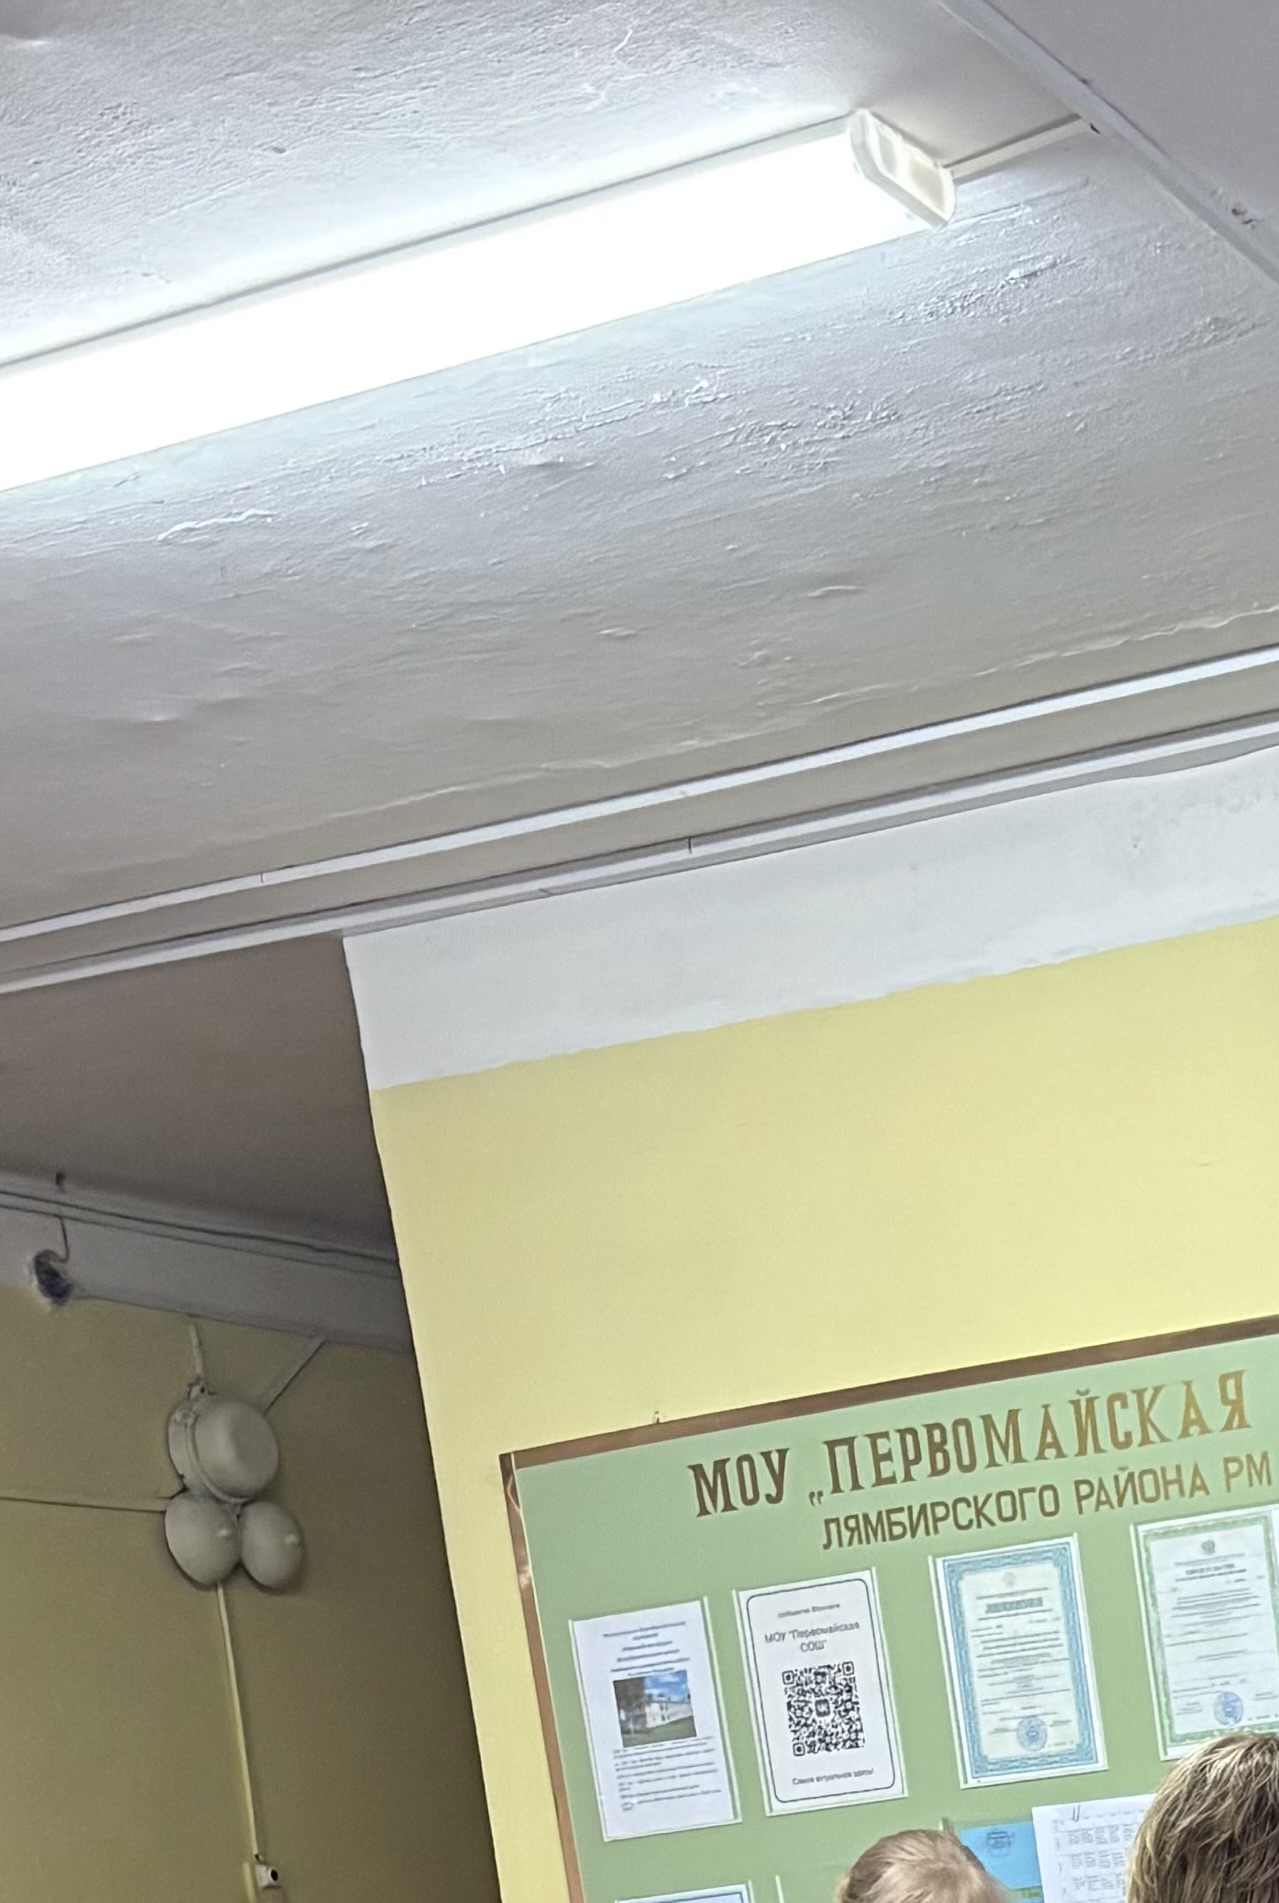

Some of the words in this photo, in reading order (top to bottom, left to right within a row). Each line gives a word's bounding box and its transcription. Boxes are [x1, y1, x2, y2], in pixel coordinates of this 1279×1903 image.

[687, 1447, 791, 1518] МОУ
[822, 1484, 1061, 1550] ЛЯМБИРСКОГО
[1075, 1462, 1210, 1518] РАЙОНА
[1223, 1450, 1273, 1494] РМ
